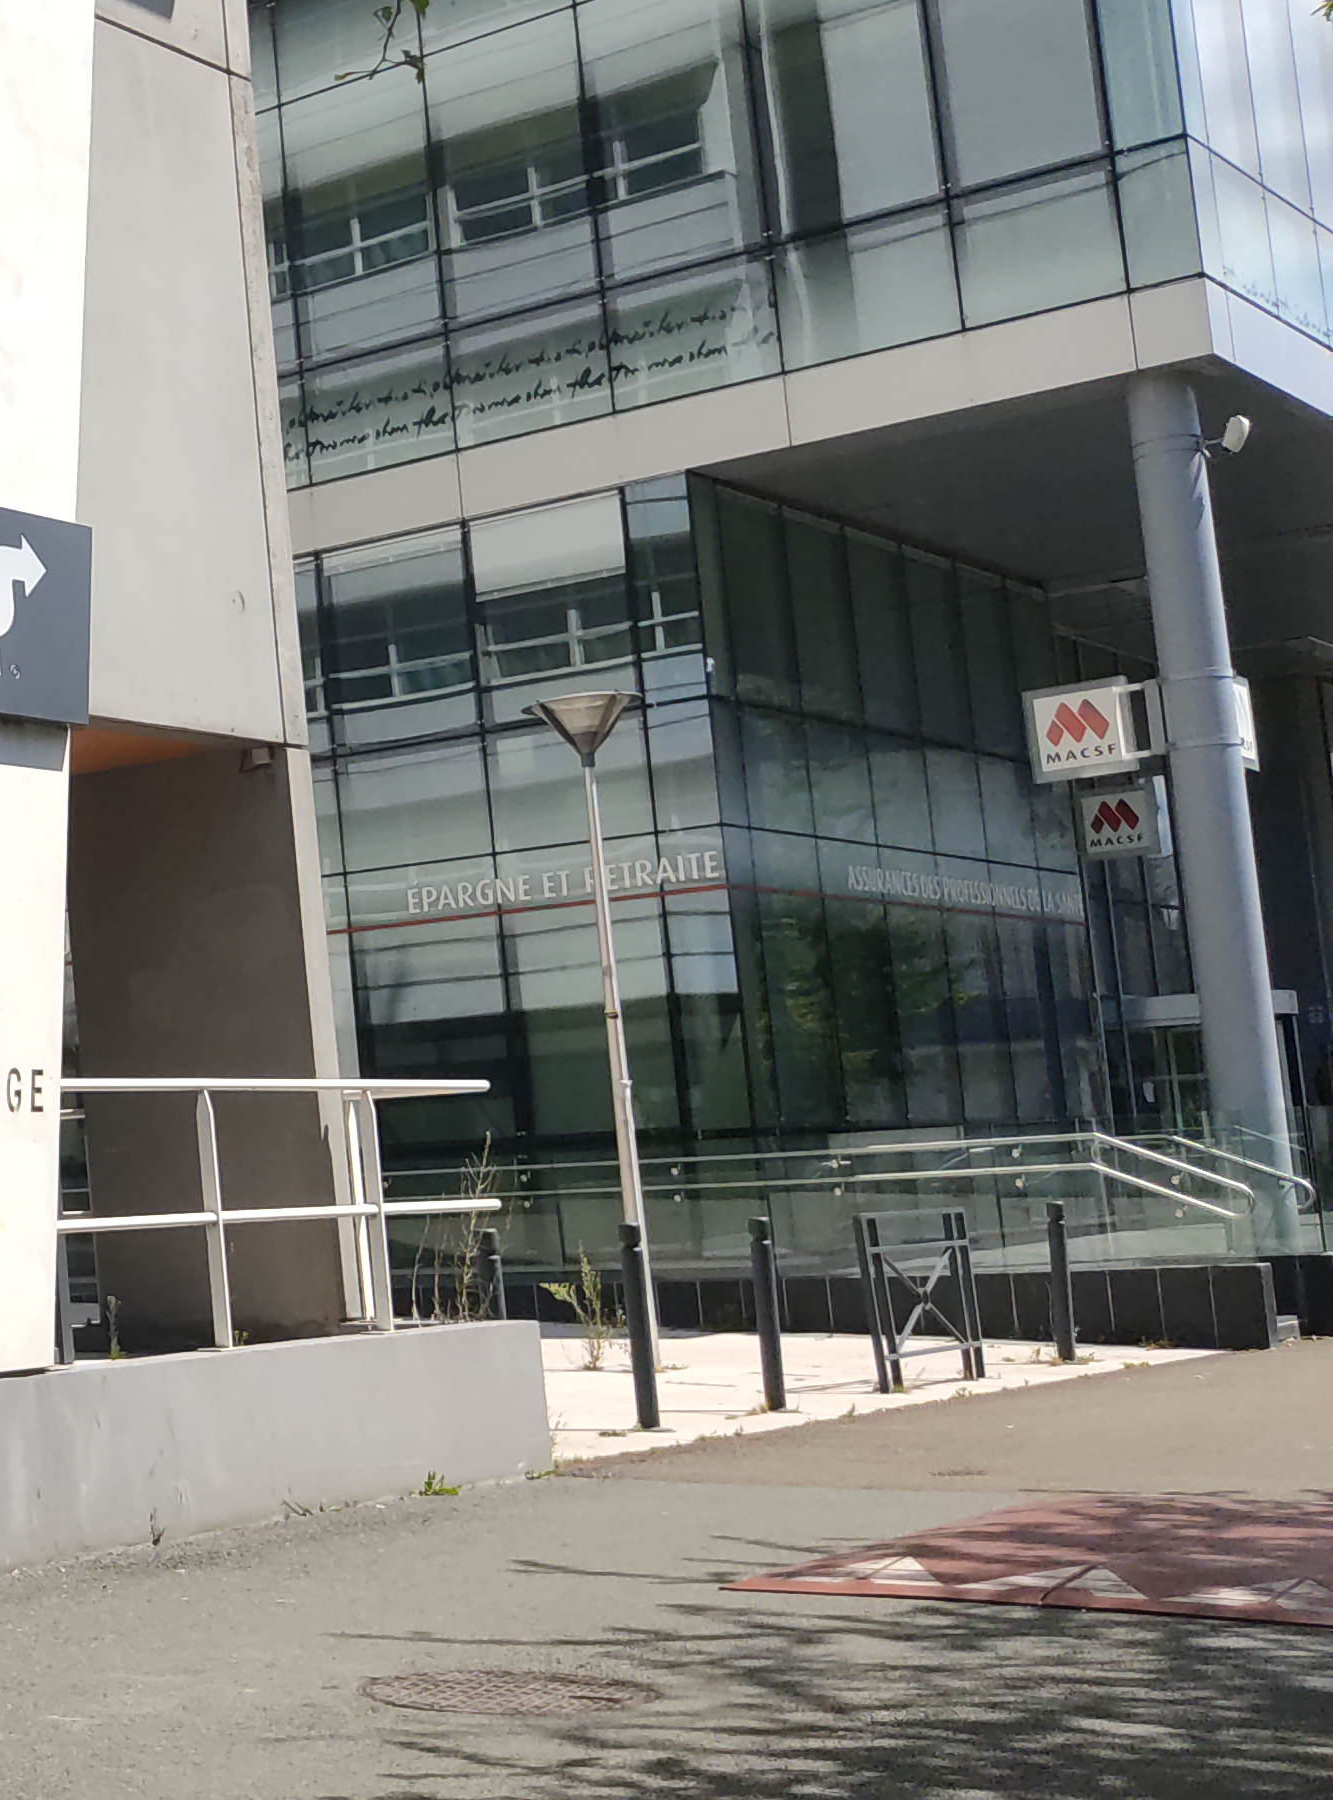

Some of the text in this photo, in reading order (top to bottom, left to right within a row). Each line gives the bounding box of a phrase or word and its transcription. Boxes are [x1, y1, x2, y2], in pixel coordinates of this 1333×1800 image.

[1046, 743, 1117, 765] MACSF
[1090, 833, 1144, 848] MACSF
[407, 874, 532, 914] ÉPARGNE
[543, 871, 569, 898] ET
[847, 865, 920, 897] ASSURANCES
[920, 876, 941, 900] DES
